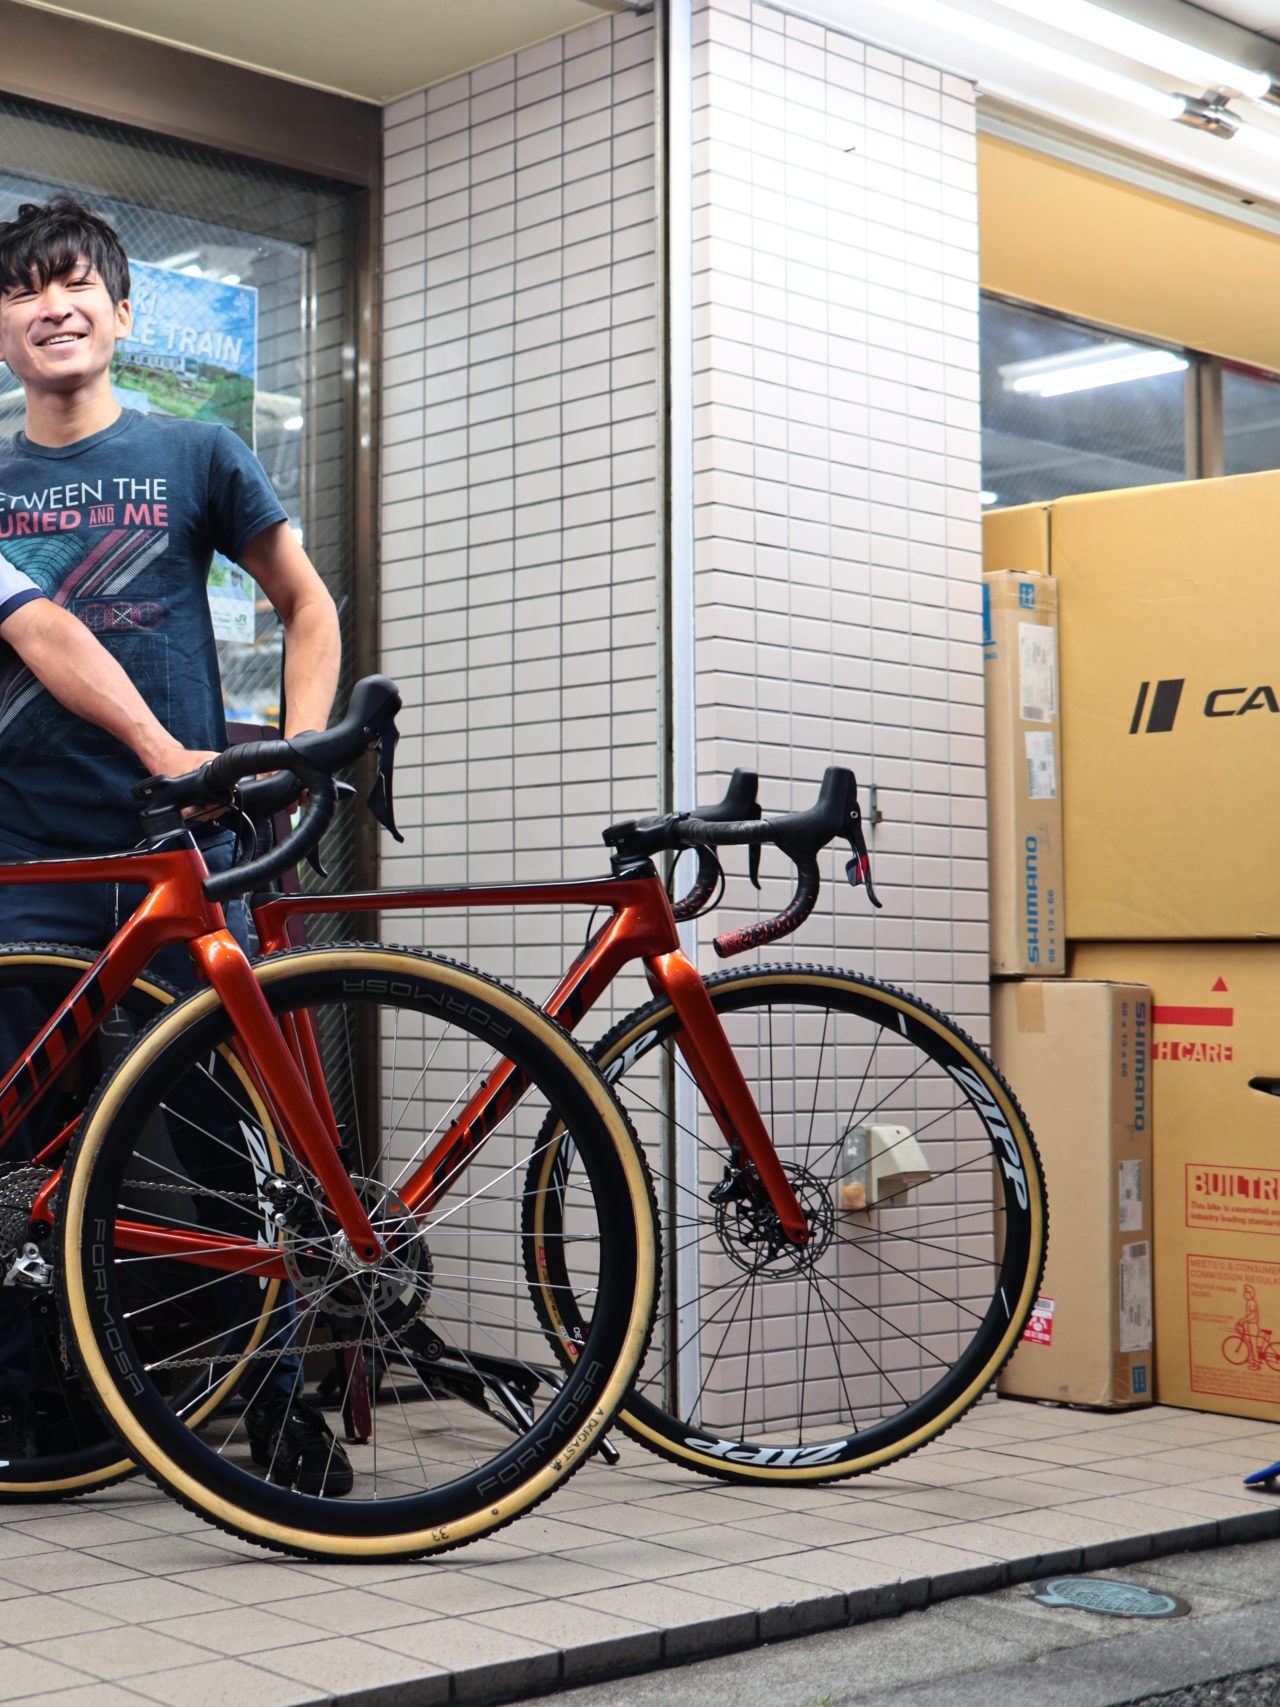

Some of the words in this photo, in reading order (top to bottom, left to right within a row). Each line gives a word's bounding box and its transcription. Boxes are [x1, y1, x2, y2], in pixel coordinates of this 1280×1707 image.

[163, 323, 243, 364] TRAIN
[112, 477, 167, 501] THE
[89, 505, 115, 526] AND
[123, 503, 169, 528] ME
[1025, 835, 1040, 963] SHIMANO
[342, 978, 513, 1040] FORMOSA
[1135, 1000, 1146, 1132] SHIMANO
[1178, 1041, 1233, 1064] CARE
[946, 1064, 1028, 1211] ZIPP
[1192, 1171, 1280, 1201] BUILTR
[91, 1218, 145, 1398] FORMOSA
[476, 1360, 604, 1497] FORMOSA
[563, 1418, 599, 1462] DUGAST
[683, 1437, 849, 1466] ZIPP
